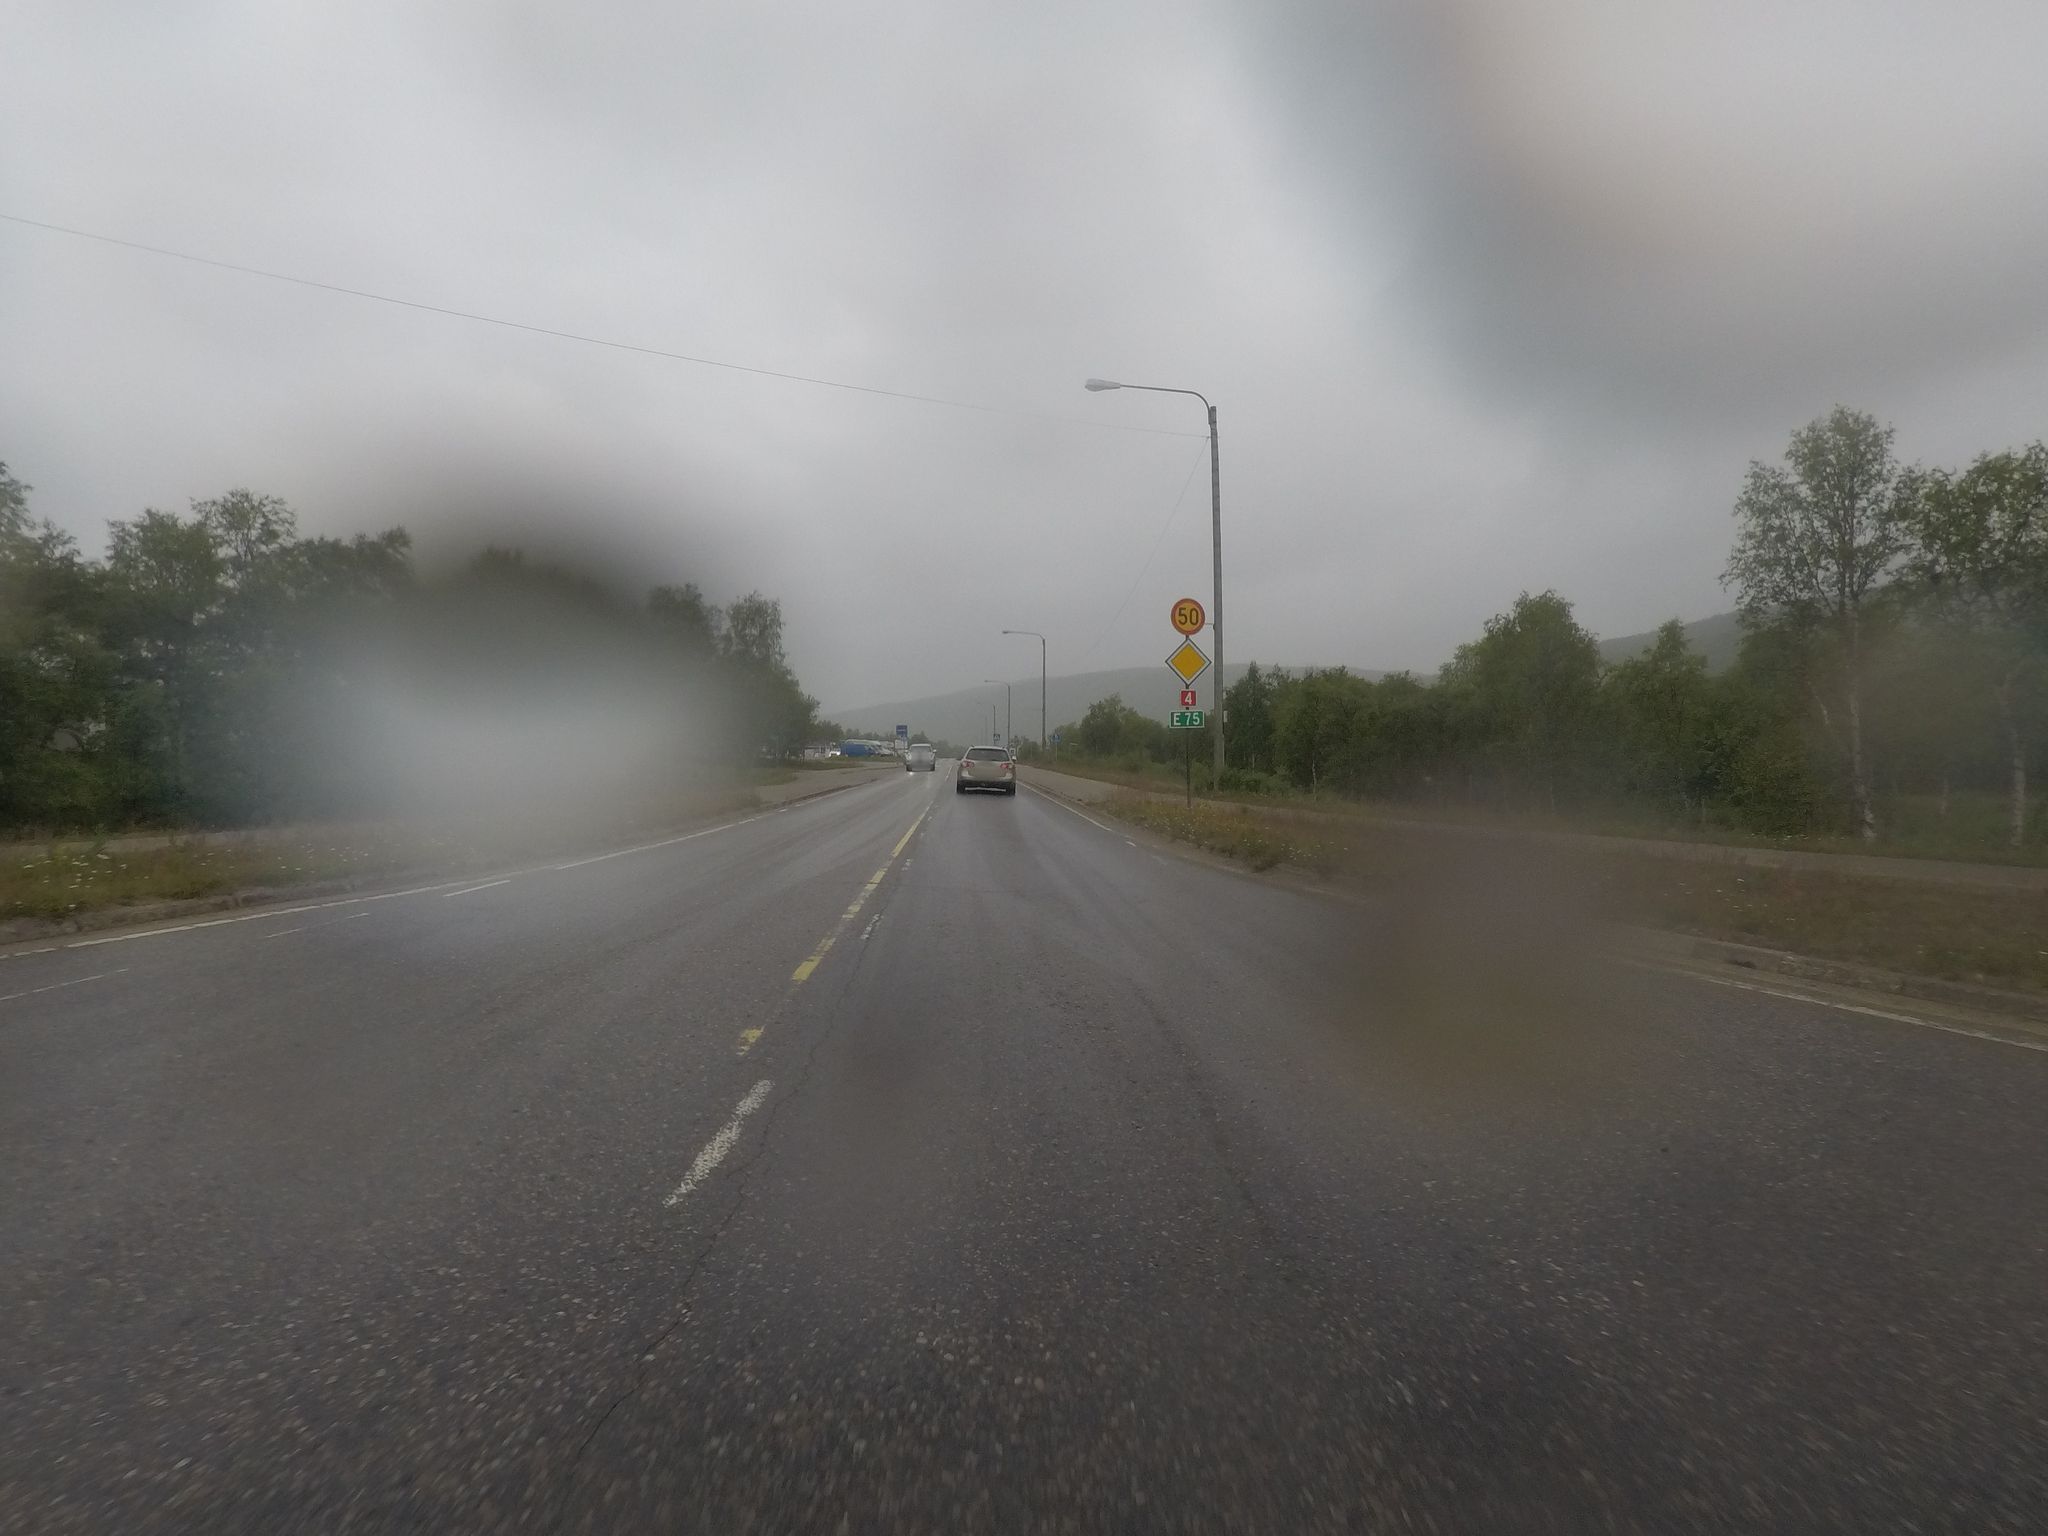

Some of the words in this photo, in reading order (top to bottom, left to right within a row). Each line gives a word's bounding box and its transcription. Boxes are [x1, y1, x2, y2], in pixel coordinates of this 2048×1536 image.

[1178, 607, 1199, 626] 50
[1184, 691, 1193, 705] 4
[1173, 712, 1181, 726] E
[1184, 712, 1200, 726] 75
